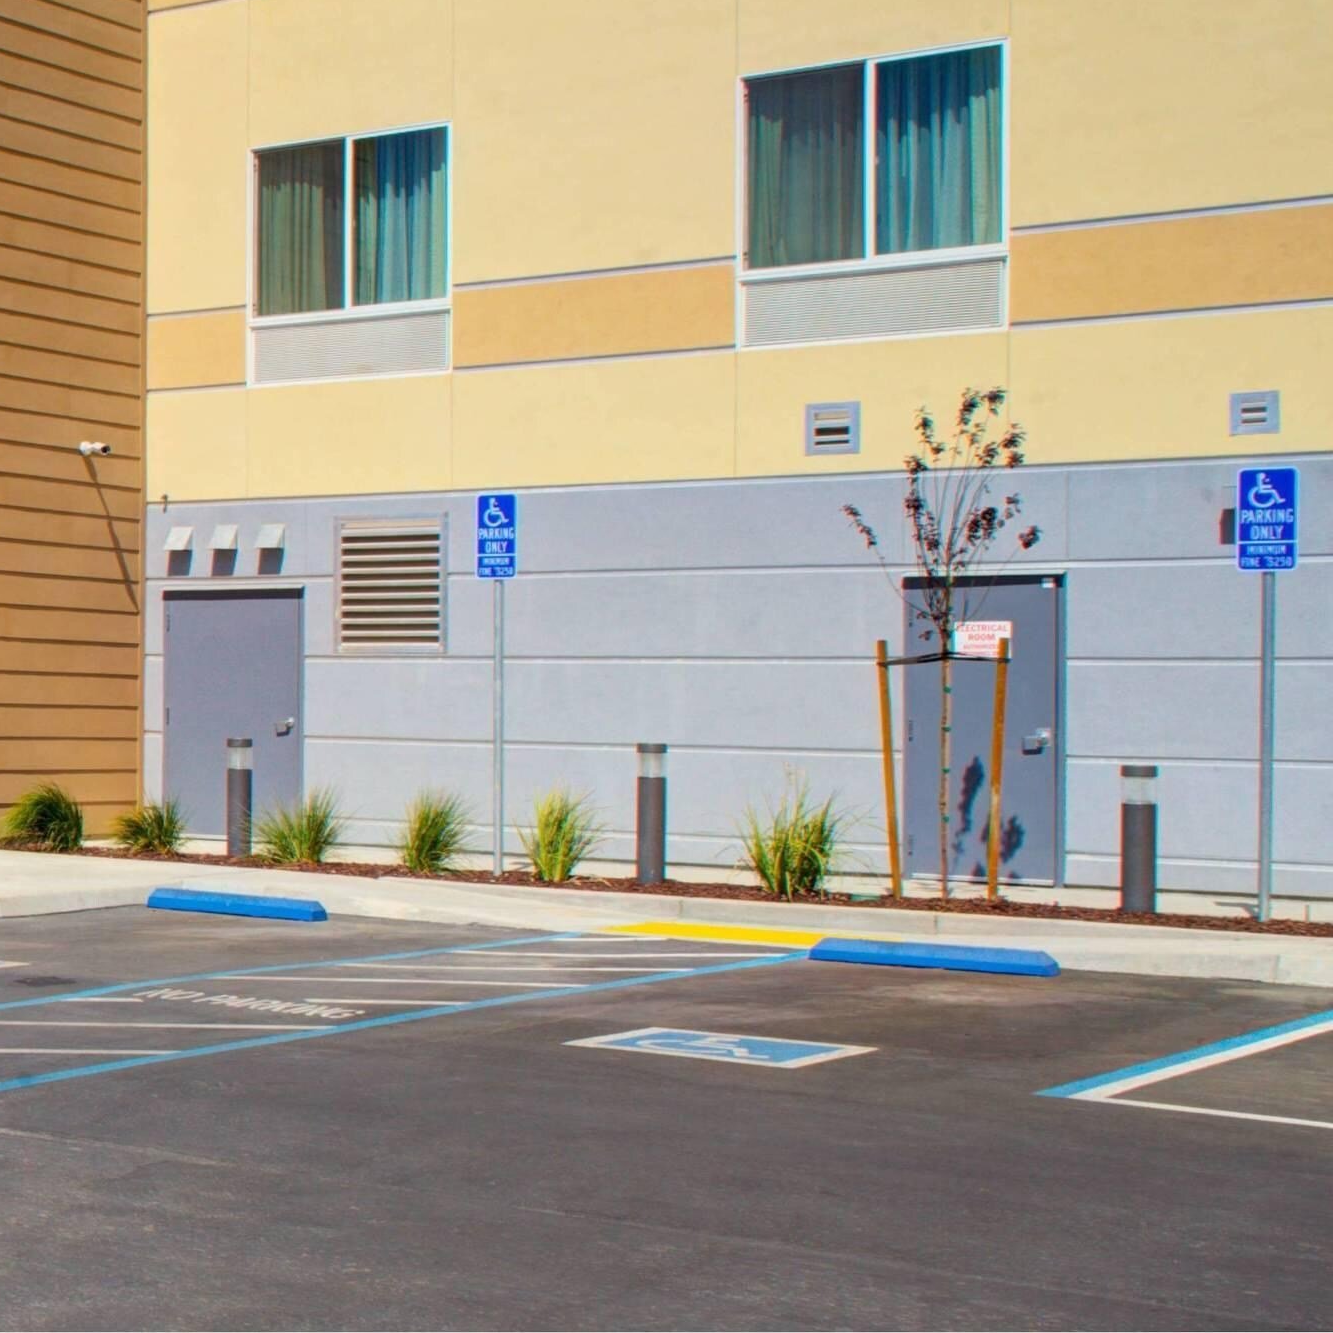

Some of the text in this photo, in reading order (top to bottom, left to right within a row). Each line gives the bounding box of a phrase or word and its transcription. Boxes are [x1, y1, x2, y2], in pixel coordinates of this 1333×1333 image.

[1241, 508, 1294, 524] PARKING
[478, 527, 514, 539] PARKING
[1250, 525, 1284, 540] ONLY
[485, 541, 508, 554] ONLY
[1247, 545, 1286, 555] MINIMUM
[1241, 556, 1261, 567] FINE
[967, 633, 996, 642] ROOM
[134, 988, 366, 1019] NO PARKING
